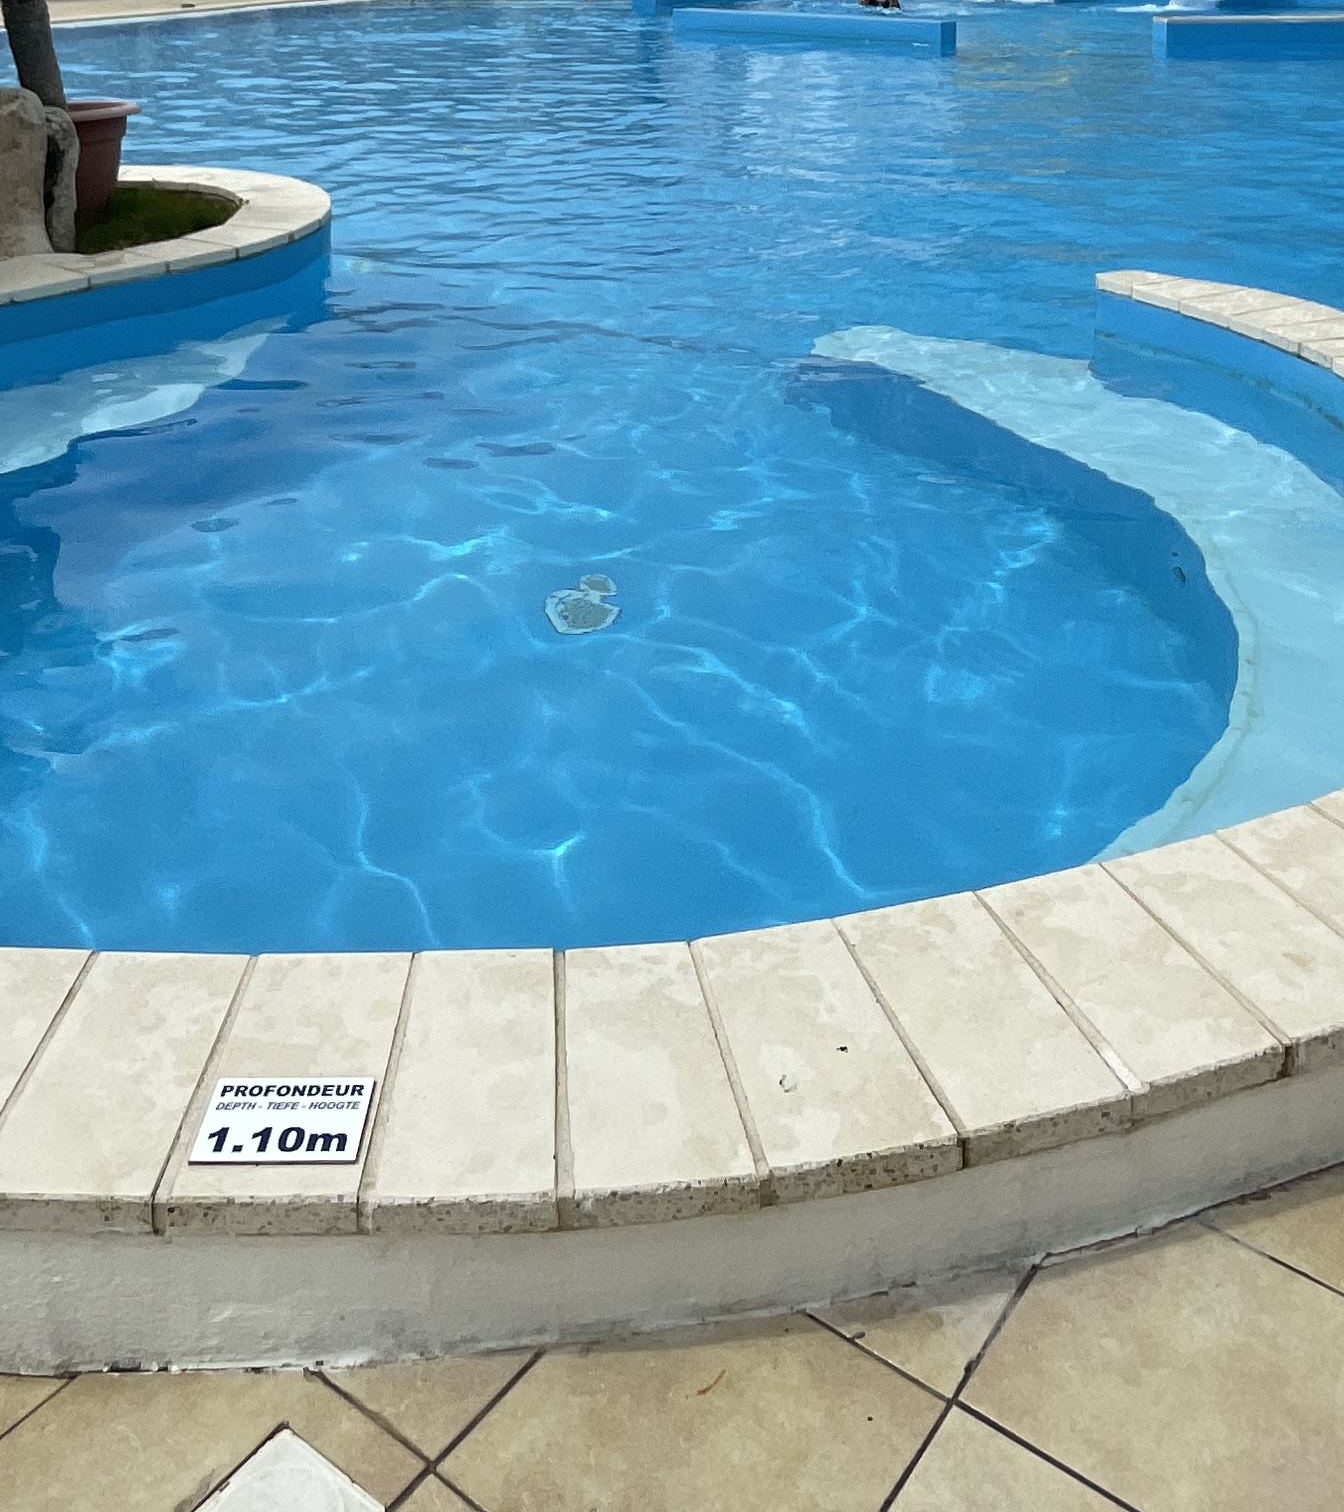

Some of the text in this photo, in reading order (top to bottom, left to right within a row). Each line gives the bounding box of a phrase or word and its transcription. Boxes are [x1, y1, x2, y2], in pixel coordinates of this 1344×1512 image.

[220, 1085, 365, 1097] PROFONDEUR
[215, 1102, 257, 1110] DEPTH
[267, 1102, 300, 1110] TIEFE
[308, 1101, 361, 1110] HOOGTE
[208, 1127, 348, 1153] 1.10m
